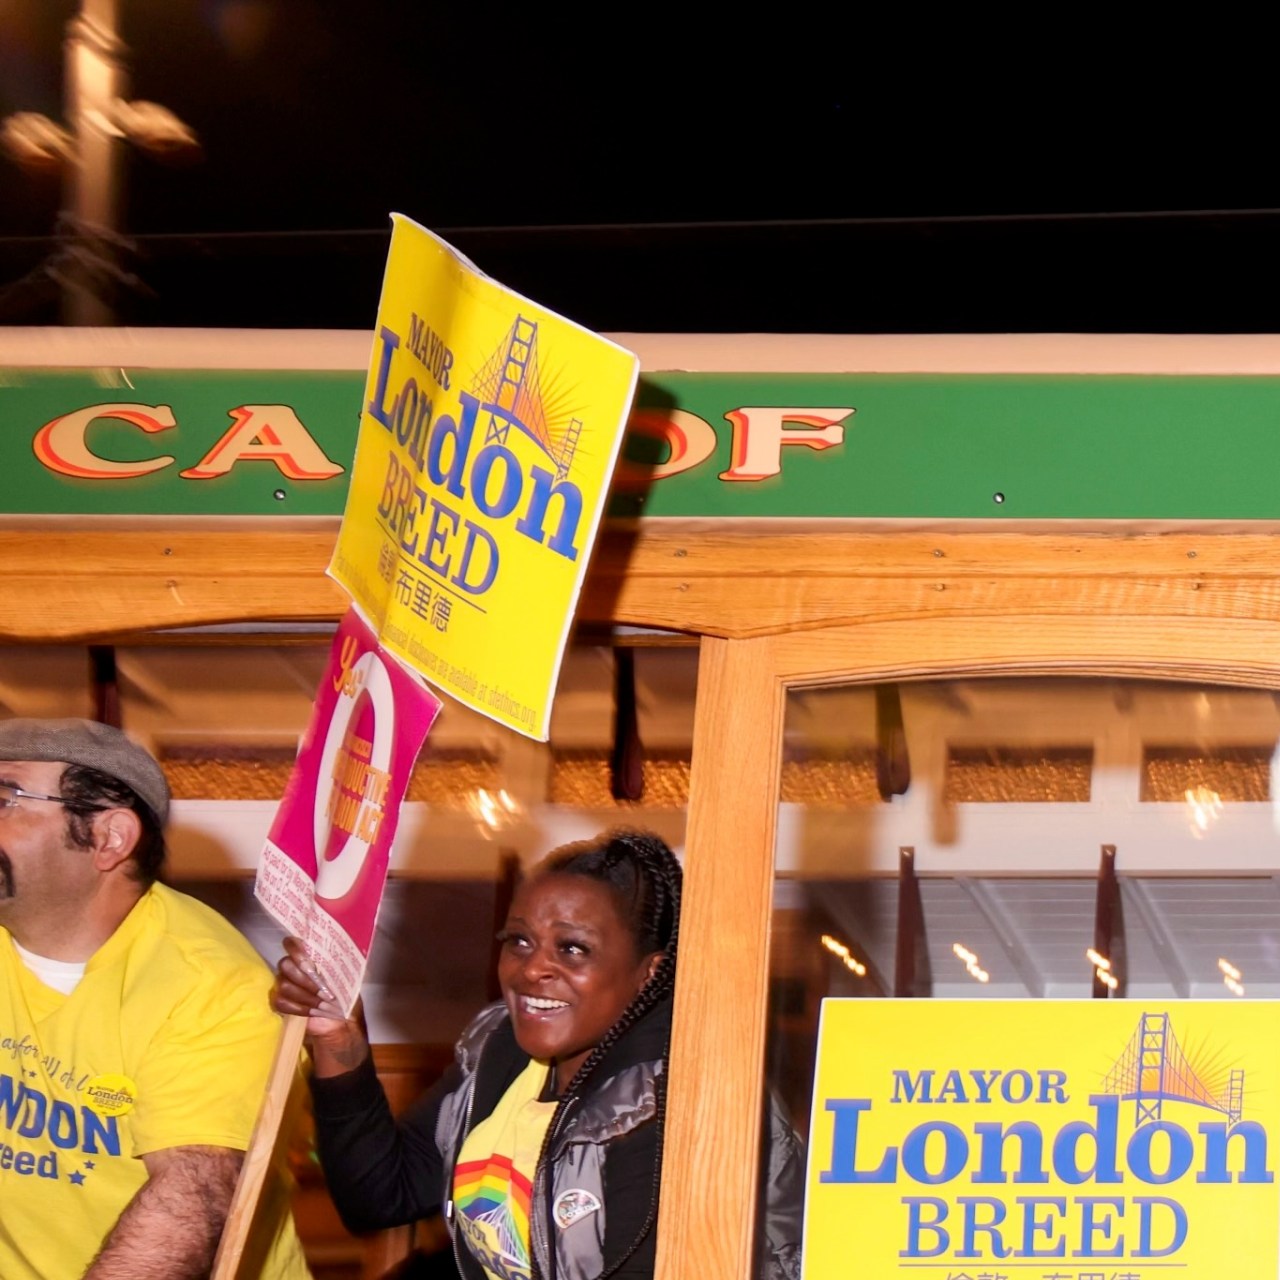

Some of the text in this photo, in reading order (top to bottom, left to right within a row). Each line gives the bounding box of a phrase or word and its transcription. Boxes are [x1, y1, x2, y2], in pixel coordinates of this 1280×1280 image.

[405, 312, 454, 391] MAYOR
[368, 325, 583, 561] London
[377, 450, 499, 596] BREED
[88, 1086, 134, 1105] London
[889, 1069, 1070, 1104] MAYOR
[819, 1094, 1274, 1184] London
[898, 1195, 1188, 1259] BREED
